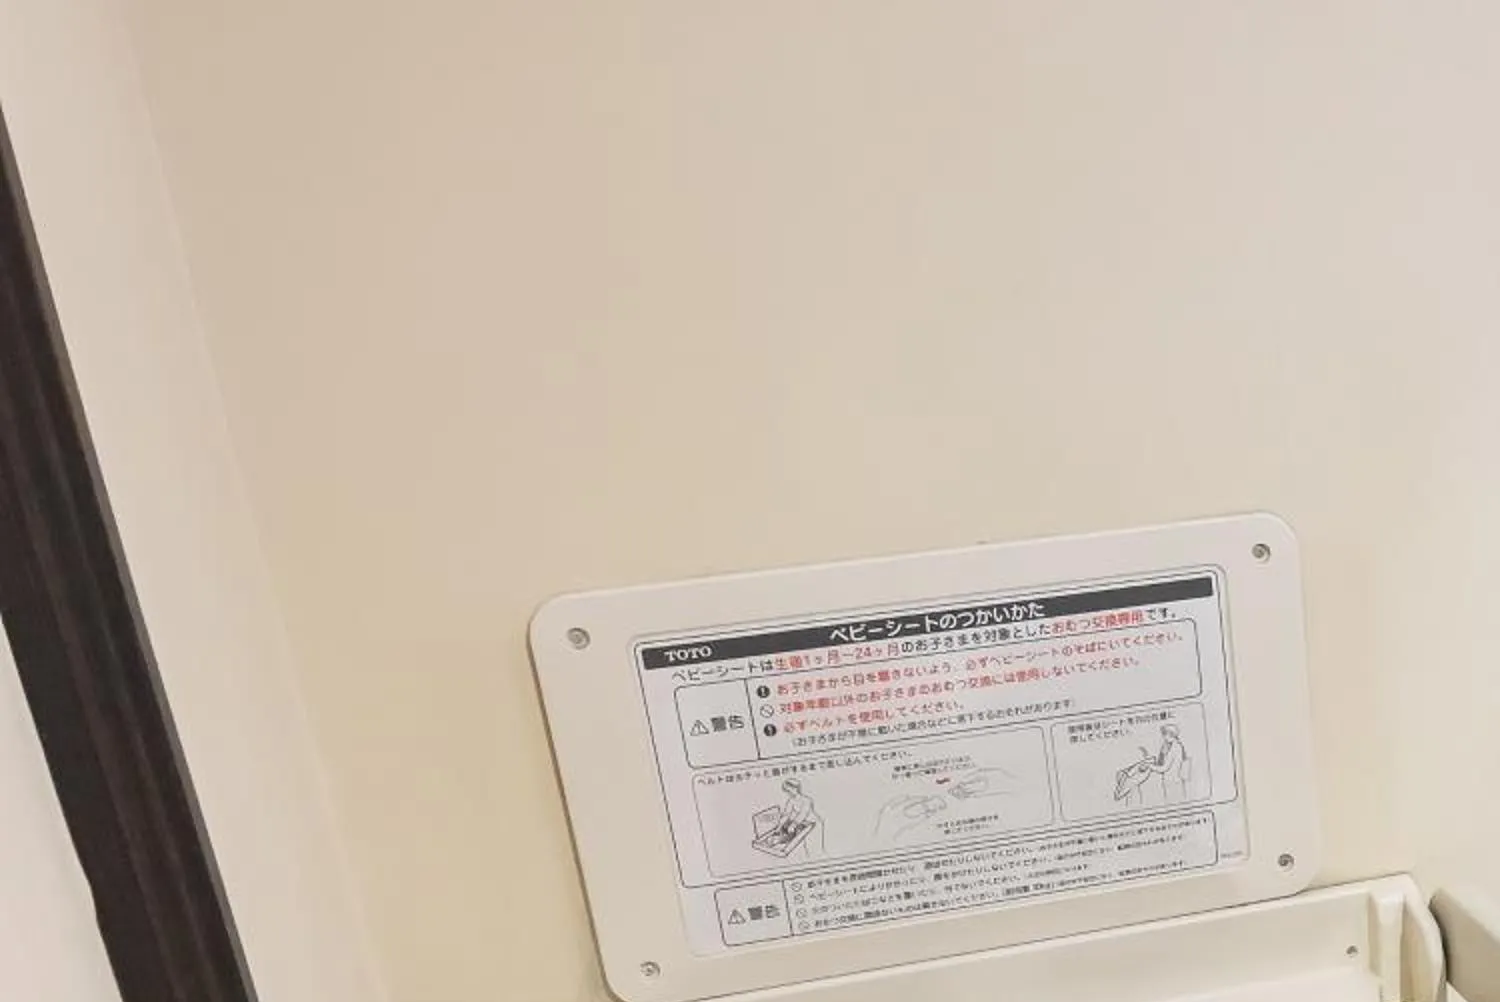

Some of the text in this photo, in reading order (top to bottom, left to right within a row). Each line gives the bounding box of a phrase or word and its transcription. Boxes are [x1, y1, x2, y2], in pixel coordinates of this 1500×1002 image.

[827, 600, 1046, 646] ベビーシートのつかいかた
[663, 644, 713, 662] TOTO
[709, 712, 746, 732] 警告
